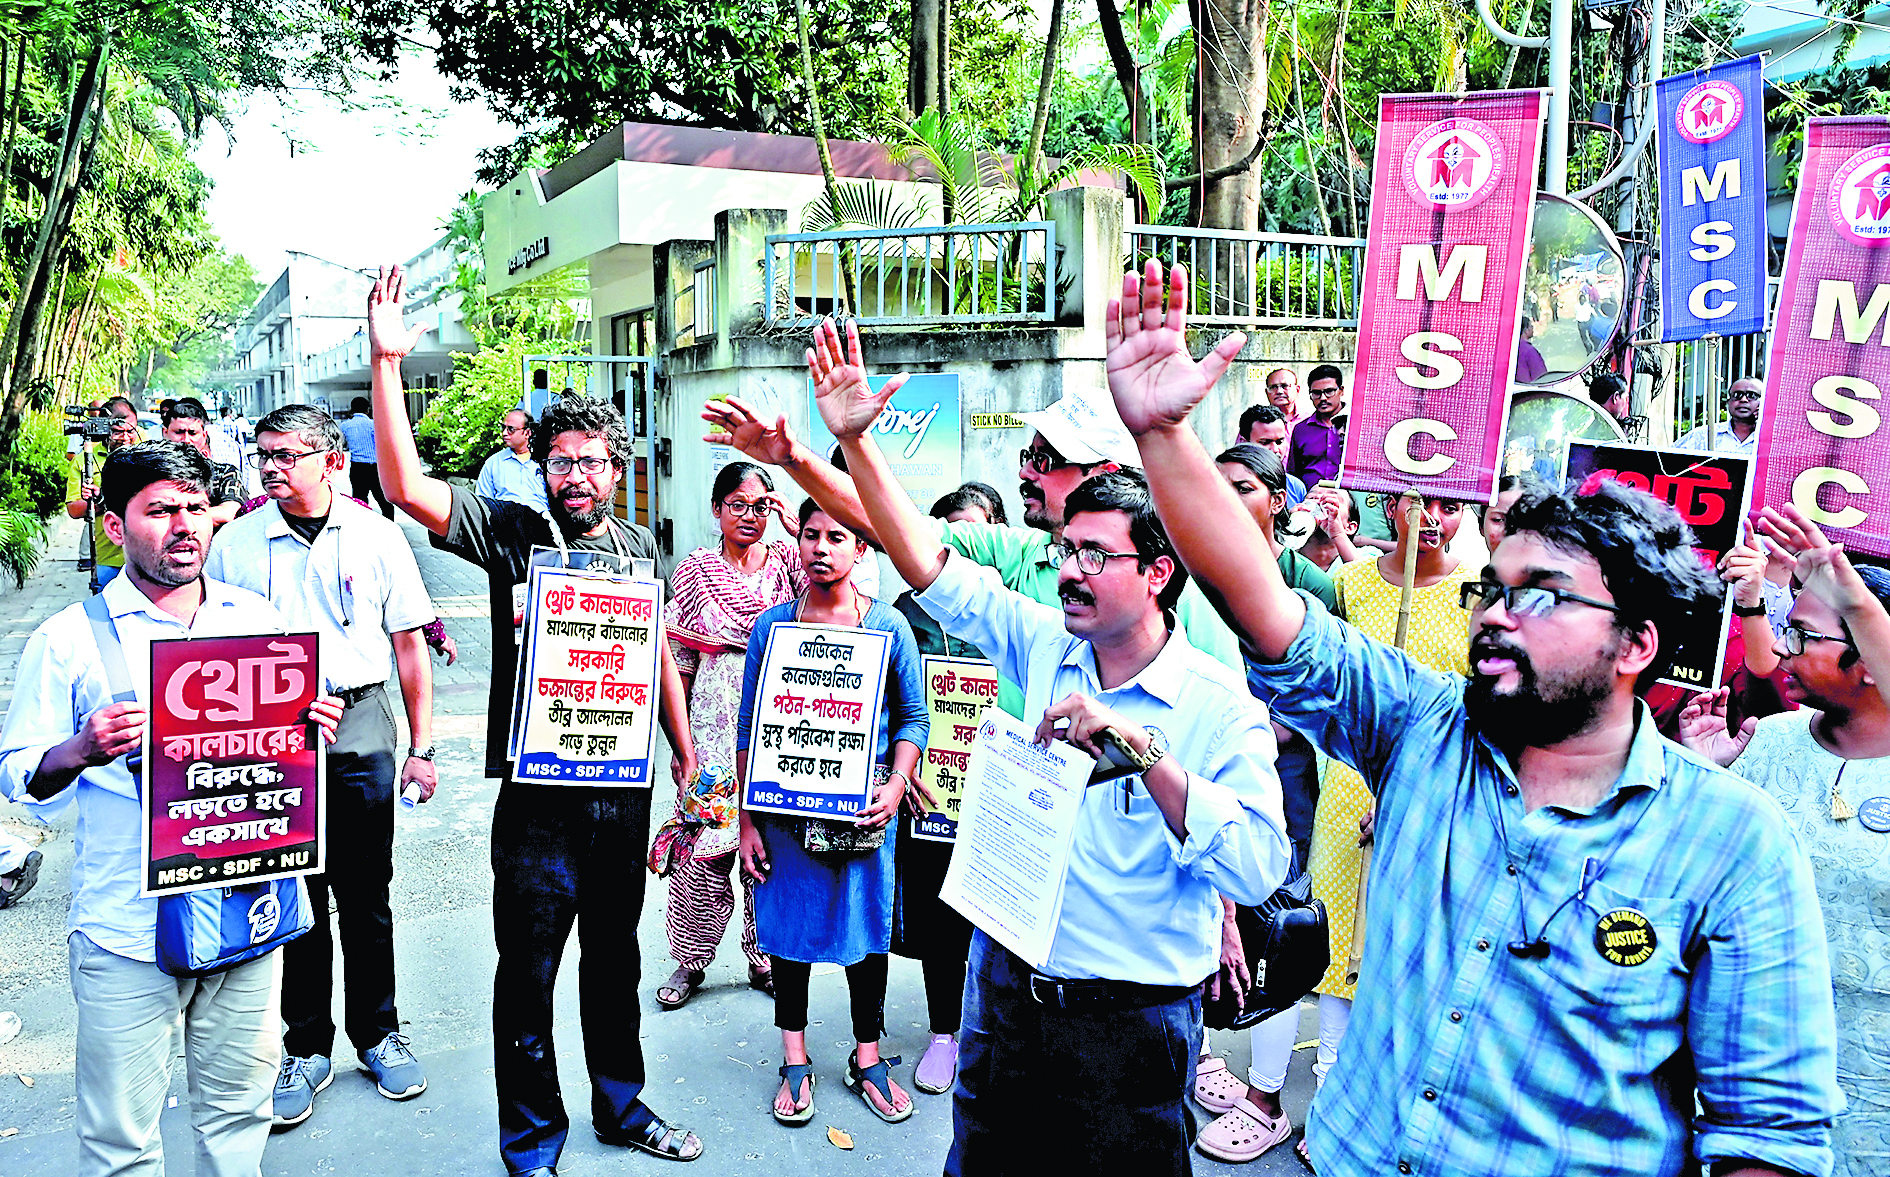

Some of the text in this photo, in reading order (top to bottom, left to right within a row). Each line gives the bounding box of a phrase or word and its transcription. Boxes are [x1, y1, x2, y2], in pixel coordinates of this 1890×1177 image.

[1405, 146, 1419, 196] VOLUNTARY
[1416, 122, 1452, 146] SERVICE
[1455, 121, 1474, 130] FOR
[1480, 163, 1501, 196] HEALTH
[1831, 148, 1885, 226] VOLUNTARY SERVICE
[1681, 158, 1741, 320] MSC
[1383, 243, 1489, 476] MSC
[972, 415, 991, 426] STICK
[993, 414, 1002, 426] NO
[890, 463, 943, 476] HAWAN
[545, 585, 575, 615] থ্রেট
[580, 592, 652, 621] কালচারের
[546, 616, 648, 645] মাথাদের বাঁচানোর
[568, 644, 625, 674] সরকারি
[799, 635, 854, 661] মেডিকেল
[165, 641, 308, 722] থ্রেট
[781, 664, 863, 690] কলেজগুলিতে
[932, 670, 956, 696] থ্রেট
[1673, 665, 1702, 681] NU
[538, 674, 648, 706] চক্রান্তের বিরুদ্ধে
[548, 699, 633, 727] তীব্র আন্দোলন
[774, 689, 863, 724] পঠন-পাঠনের
[934, 699, 976, 719] মাথাদের
[163, 724, 306, 762] কালচারের
[559, 733, 617, 755] গড়ে তুলুন
[762, 720, 865, 751] সুস্থ পরিবেশ রক্ষা
[1006, 730, 1026, 745] MEDICAL
[1049, 752, 1067, 767] CENTRE
[526, 763, 640, 778] MSC SDF NU
[778, 754, 842, 779] করতে হবে
[928, 748, 971, 772] চক্রান্তে
[937, 768, 957, 793] তীব্র
[167, 787, 302, 820] লড়তে হবে
[754, 791, 858, 812] MSC SDF NU
[1866, 808, 1890, 819] JUSTIC
[182, 816, 289, 846] একসাথে
[921, 822, 950, 834] MSC
[158, 851, 309, 885] MSC SDF NU
[1598, 911, 1646, 930] WE DEMAND
[1605, 929, 1648, 947] JUSTICE
[1605, 948, 1622, 963] FOR
